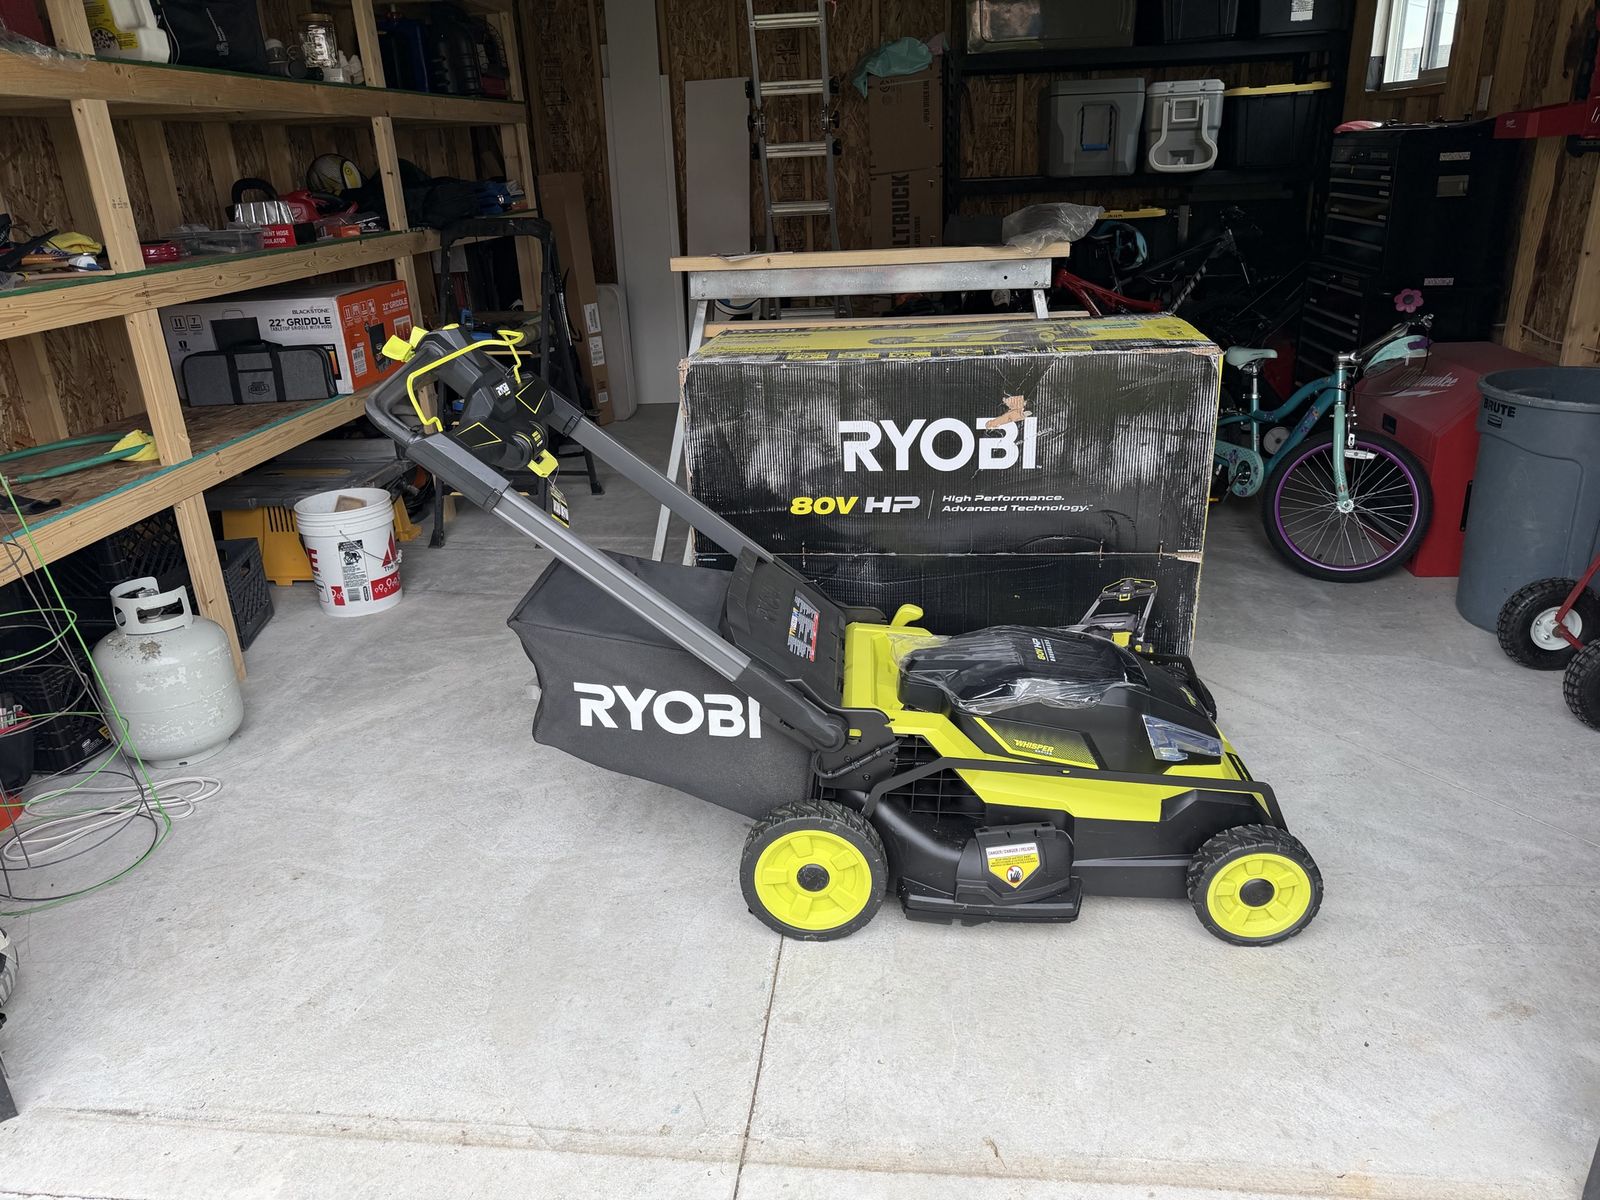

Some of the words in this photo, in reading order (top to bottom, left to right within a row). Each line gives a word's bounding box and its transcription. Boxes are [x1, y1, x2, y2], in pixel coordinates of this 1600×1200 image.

[891, 174, 910, 248] LTRUCK
[268, 318, 286, 327] 22"
[286, 316, 332, 327] GRIDDLE
[1483, 398, 1516, 418] BRUTE
[838, 417, 1038, 472] RYOBI
[789, 496, 859, 515] 80V
[864, 496, 921, 513] HP
[942, 495, 972, 503] High
[974, 494, 1065, 502] Performance.
[942, 504, 1007, 512] Advanced
[573, 682, 761, 739] RYOBI
[1014, 739, 1055, 753] WHISPER
